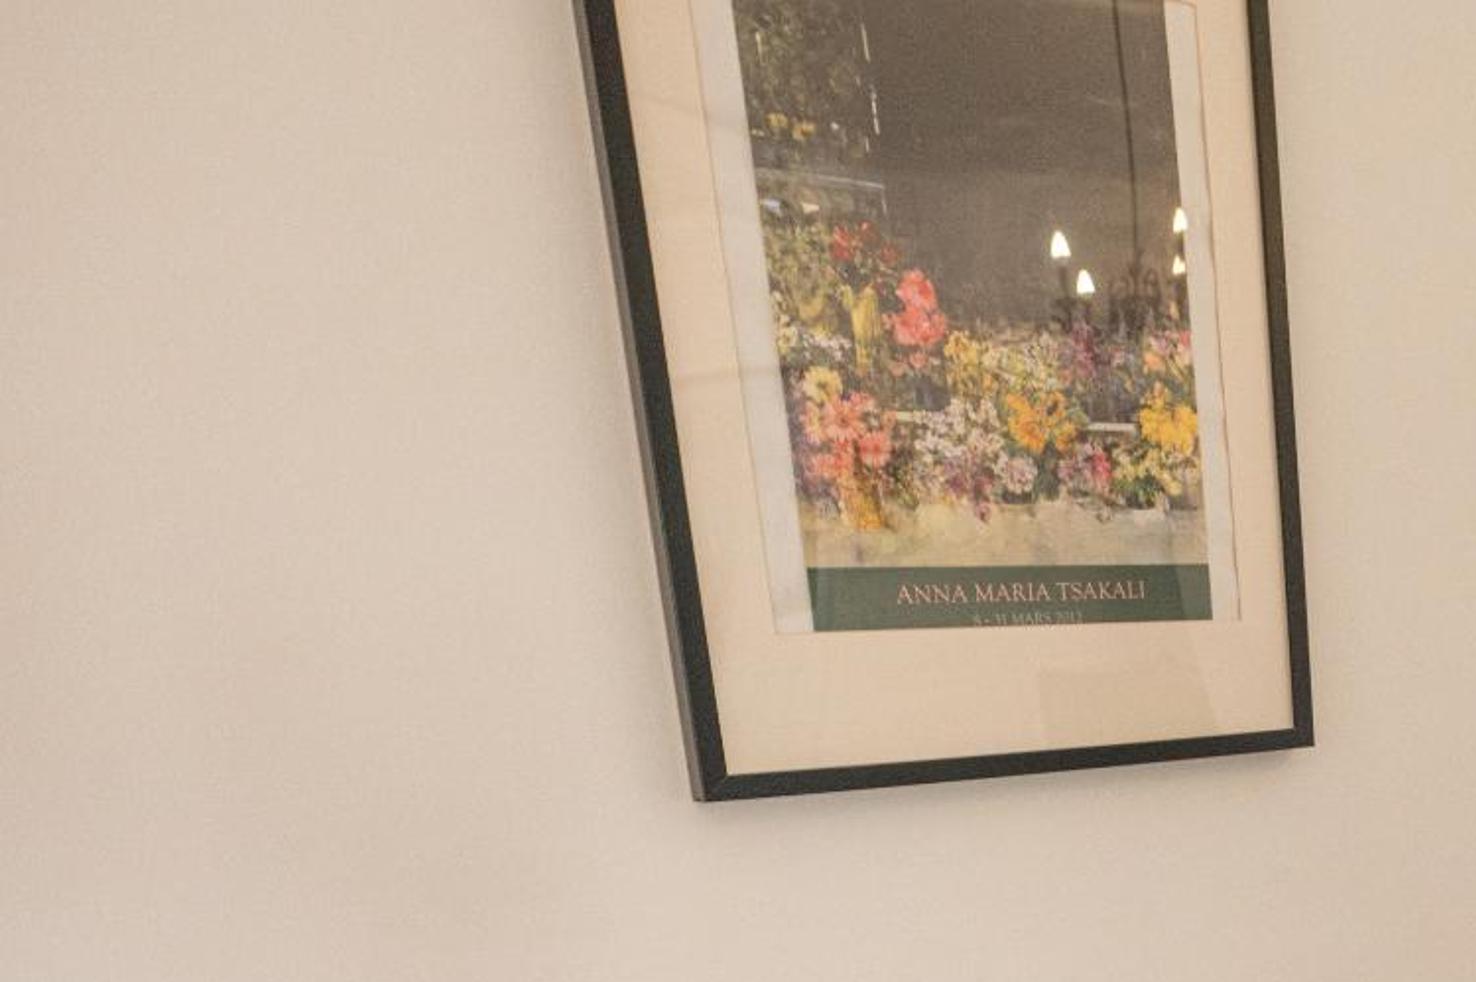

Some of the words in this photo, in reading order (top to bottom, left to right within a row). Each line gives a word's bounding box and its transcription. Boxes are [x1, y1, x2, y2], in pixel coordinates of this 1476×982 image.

[897, 584, 968, 605] ANNA
[974, 581, 1051, 603] MARIA
[1056, 579, 1147, 601] TSAKALI
[1009, 611, 1051, 624] MARS
